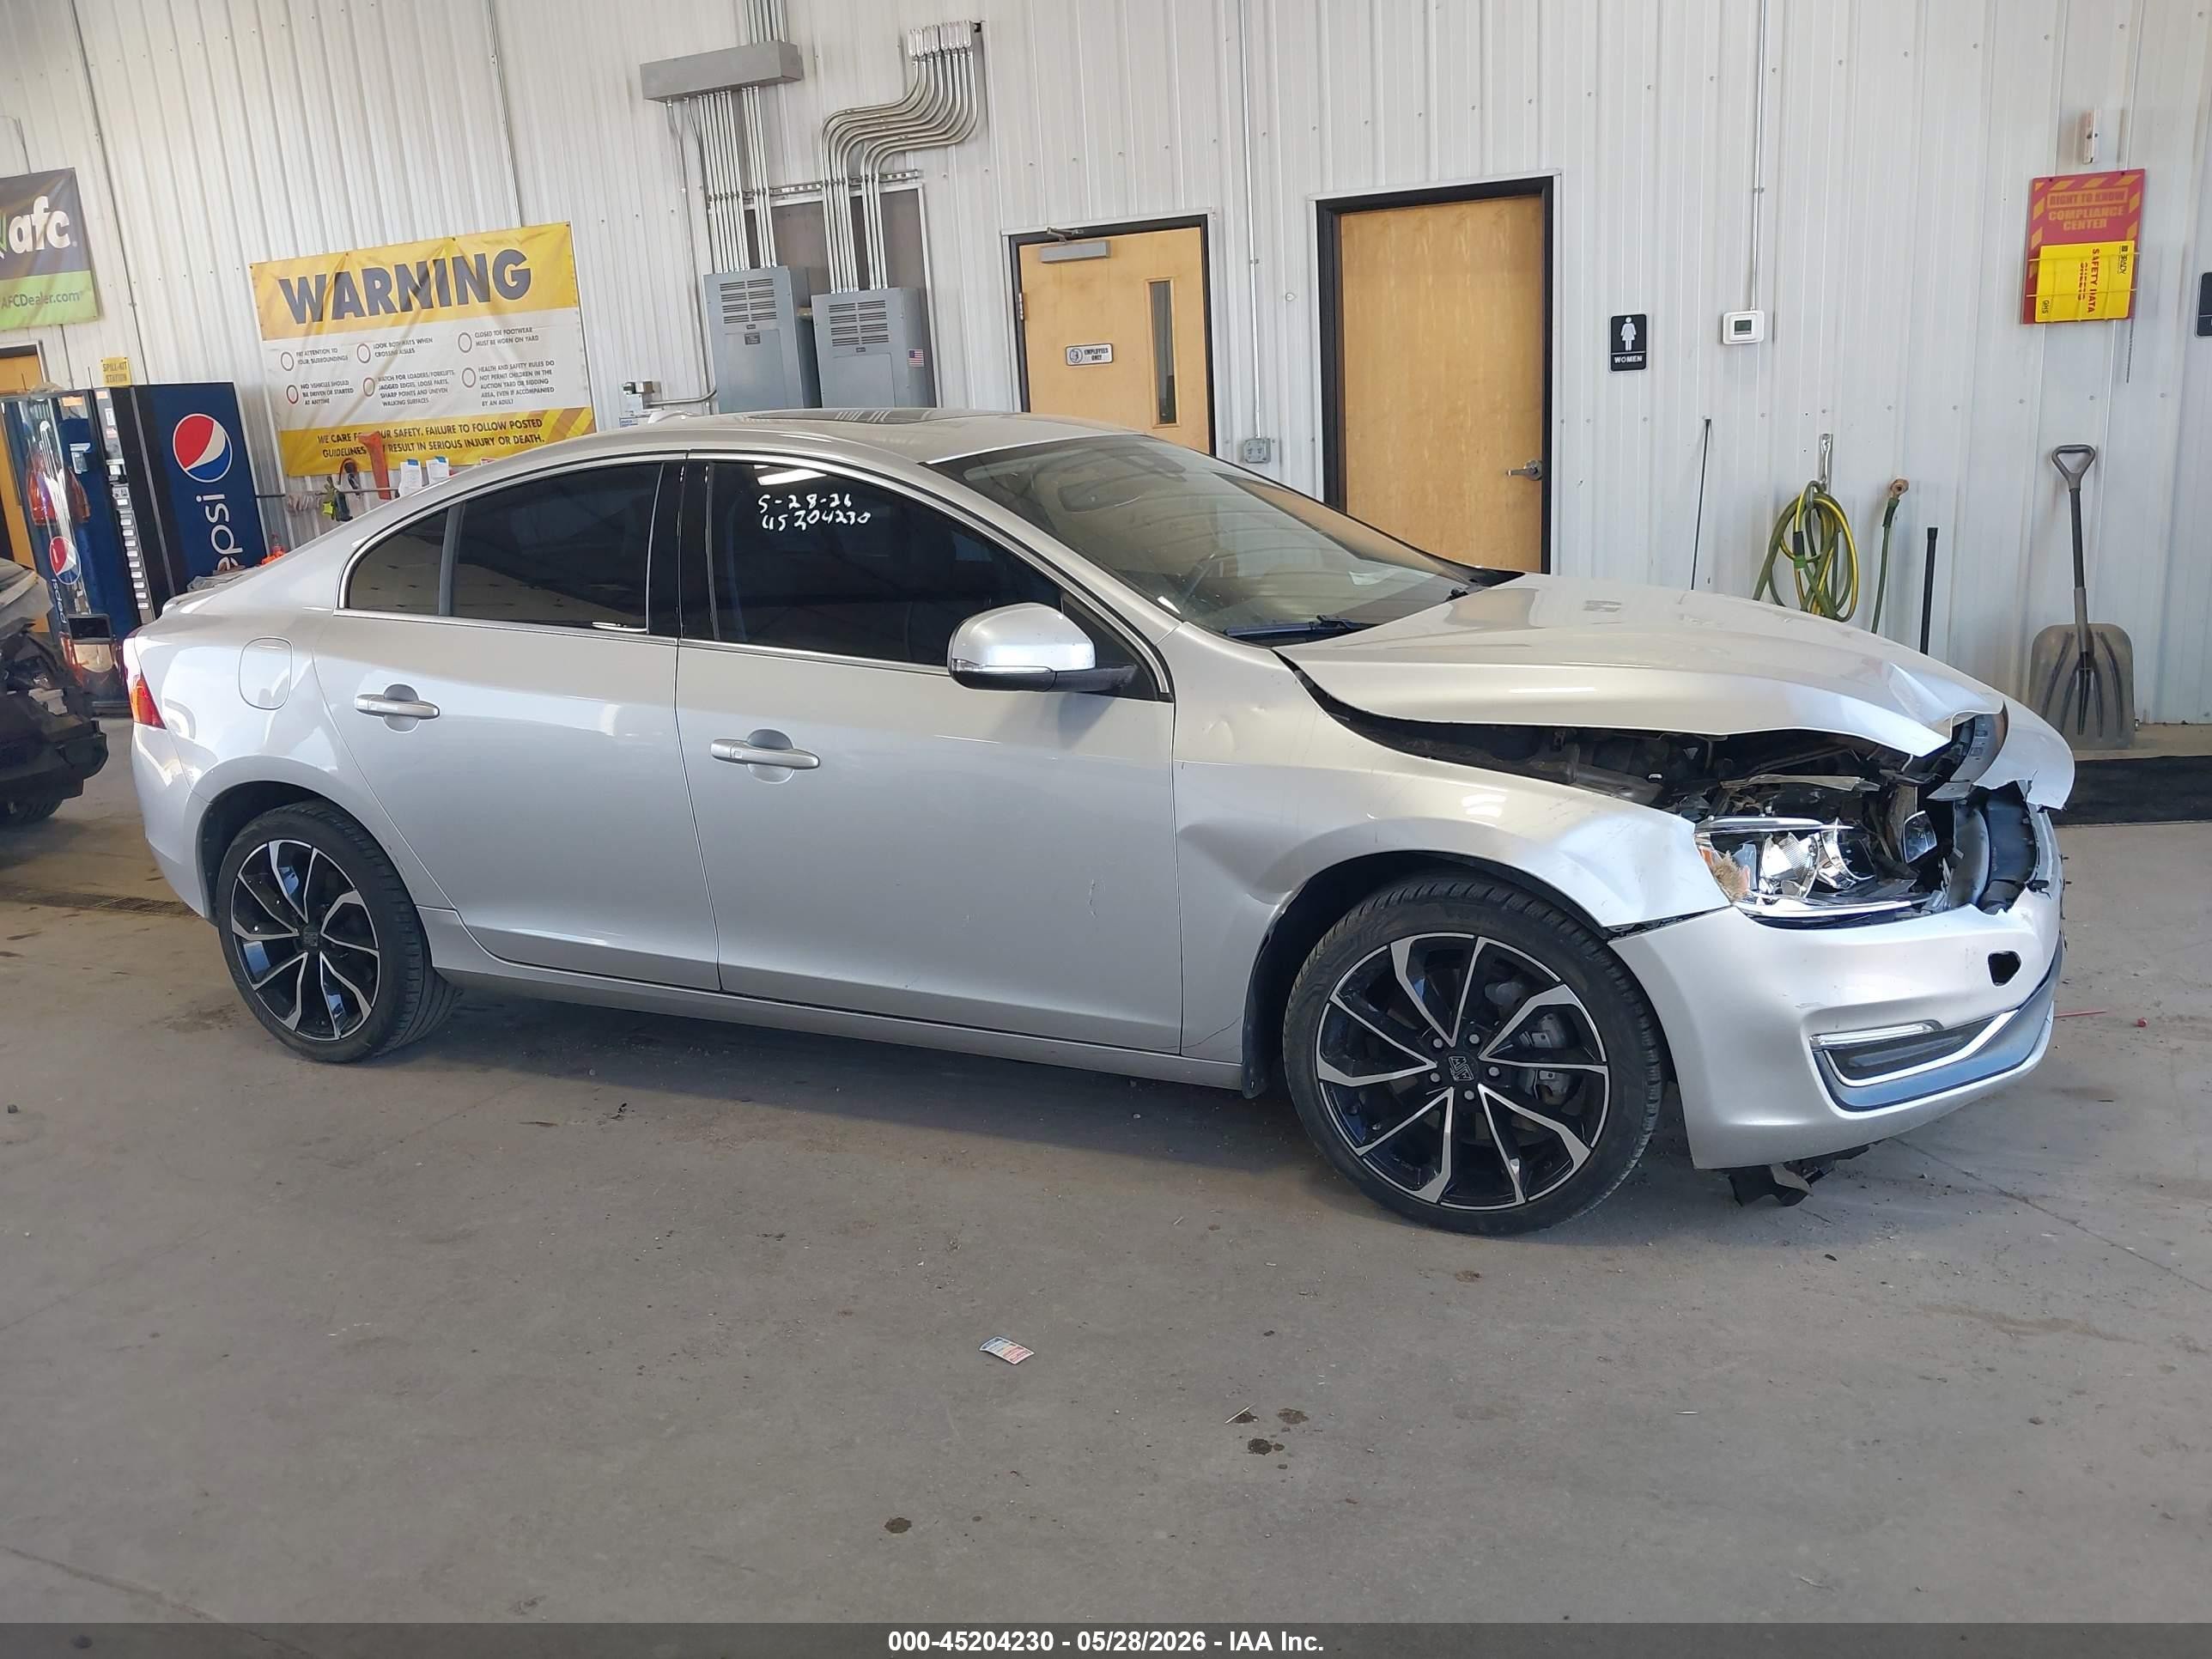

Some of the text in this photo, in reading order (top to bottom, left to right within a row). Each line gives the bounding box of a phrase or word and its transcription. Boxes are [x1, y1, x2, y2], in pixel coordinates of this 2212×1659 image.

[9, 196, 70, 254] afc
[2049, 206, 2124, 221] COMPLIANCE
[2063, 219, 2106, 230] CENTER
[2090, 248, 2100, 285] SAFETY
[278, 249, 531, 325] WARNING
[2, 290, 81, 310] AFCDealer.com
[310, 355, 349, 364] SURROUNDINGS
[1614, 355, 1643, 364] WOMEN
[516, 386, 555, 395] ACCOMPANIED
[318, 434, 329, 444] WE
[331, 433, 351, 443] CARE
[394, 428, 424, 438] SAFETY.
[426, 424, 457, 436] FAILURE
[459, 423, 470, 433] TO
[472, 421, 507, 432] FOLLOW
[509, 418, 543, 429] POSTED
[322, 447, 367, 458] GUIDELINES
[388, 442, 416, 453] RESULT
[416, 442, 427, 451] IN
[429, 439, 463, 451] SERIOUS
[464, 436, 495, 448] INJURY
[498, 435, 511, 446] OR
[514, 434, 545, 445] DEATH.
[196, 494, 244, 571] epsi
[51, 579, 67, 623] pepsi
